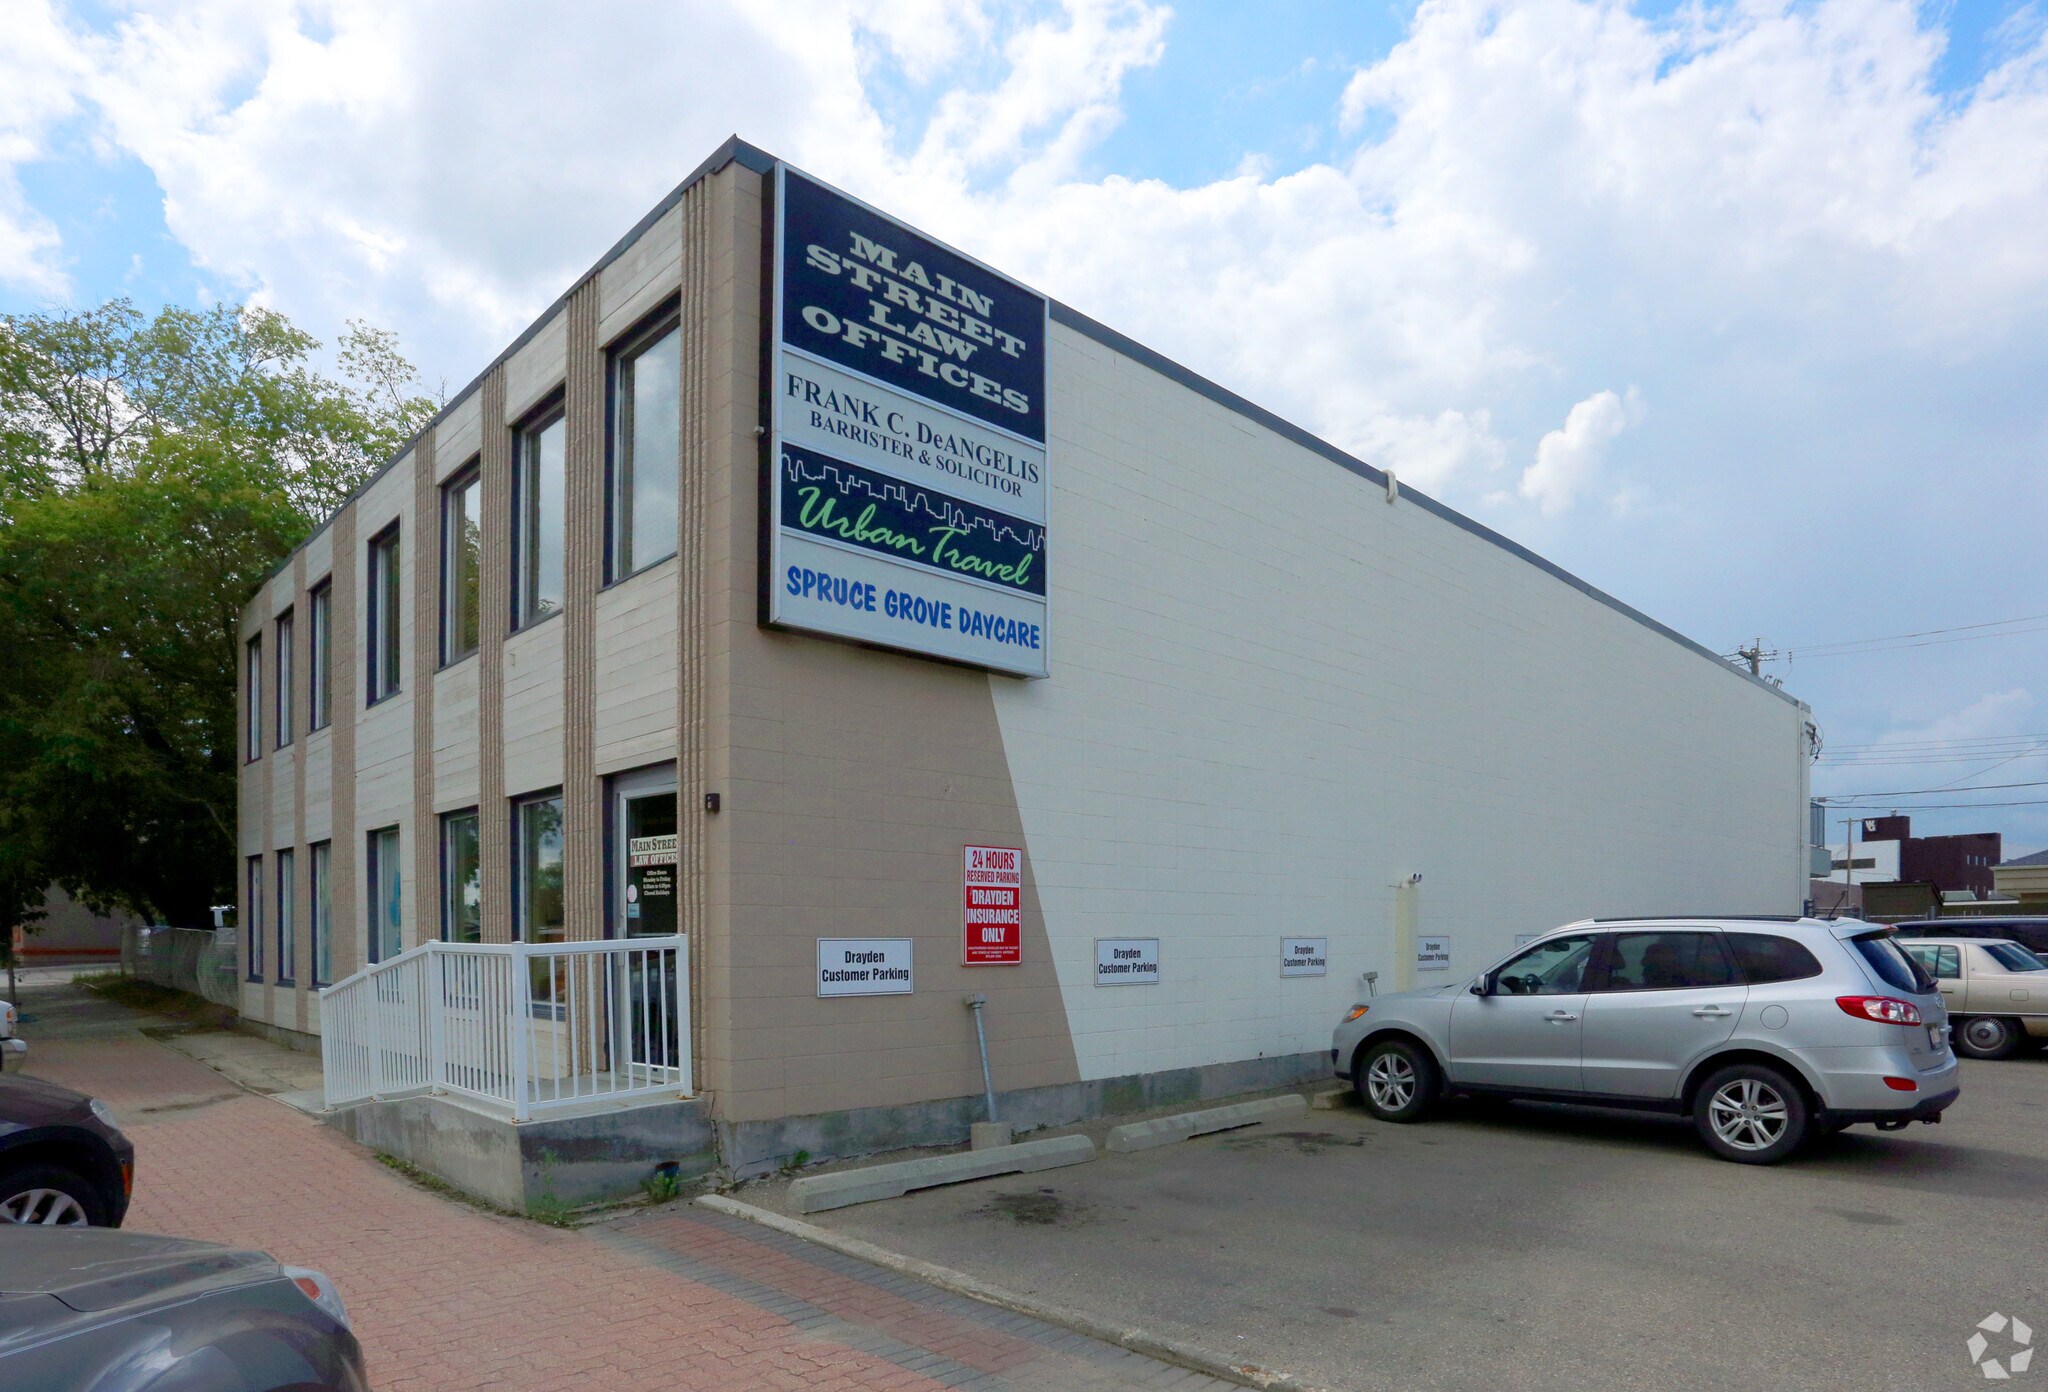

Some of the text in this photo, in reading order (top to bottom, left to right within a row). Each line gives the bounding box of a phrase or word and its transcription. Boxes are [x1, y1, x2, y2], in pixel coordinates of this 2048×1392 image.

[850, 231, 994, 317] MAIN
[806, 244, 1026, 358] STREET
[869, 299, 978, 362] LAW
[801, 305, 1030, 414] OFFICES
[786, 372, 1039, 484] FRANK C. DeANGELIS
[810, 410, 1023, 498] BARRISTER & SOLICITOR
[798, 486, 1034, 585] Urban Travel
[786, 565, 1040, 650] SPRUCE GROVE DAYCARE
[631, 838, 677, 852] MAIN STREE
[634, 855, 649, 865] LAW
[972, 850, 1015, 870] 24 HOURS
[966, 869, 1020, 884] RESERVED PARKING
[972, 889, 1014, 906] DRAYDEN
[967, 908, 1019, 924] INSURANCE
[981, 927, 1005, 943] ONLY
[1113, 948, 1141, 960] Drayden
[1294, 945, 1314, 955] Drayden
[1425, 942, 1440, 951] Drayden
[844, 950, 885, 964] Drayden
[1284, 957, 1325, 967] Customer Parking
[822, 967, 909, 982] Customer Parking
[1098, 962, 1157, 974] Customer Parking
